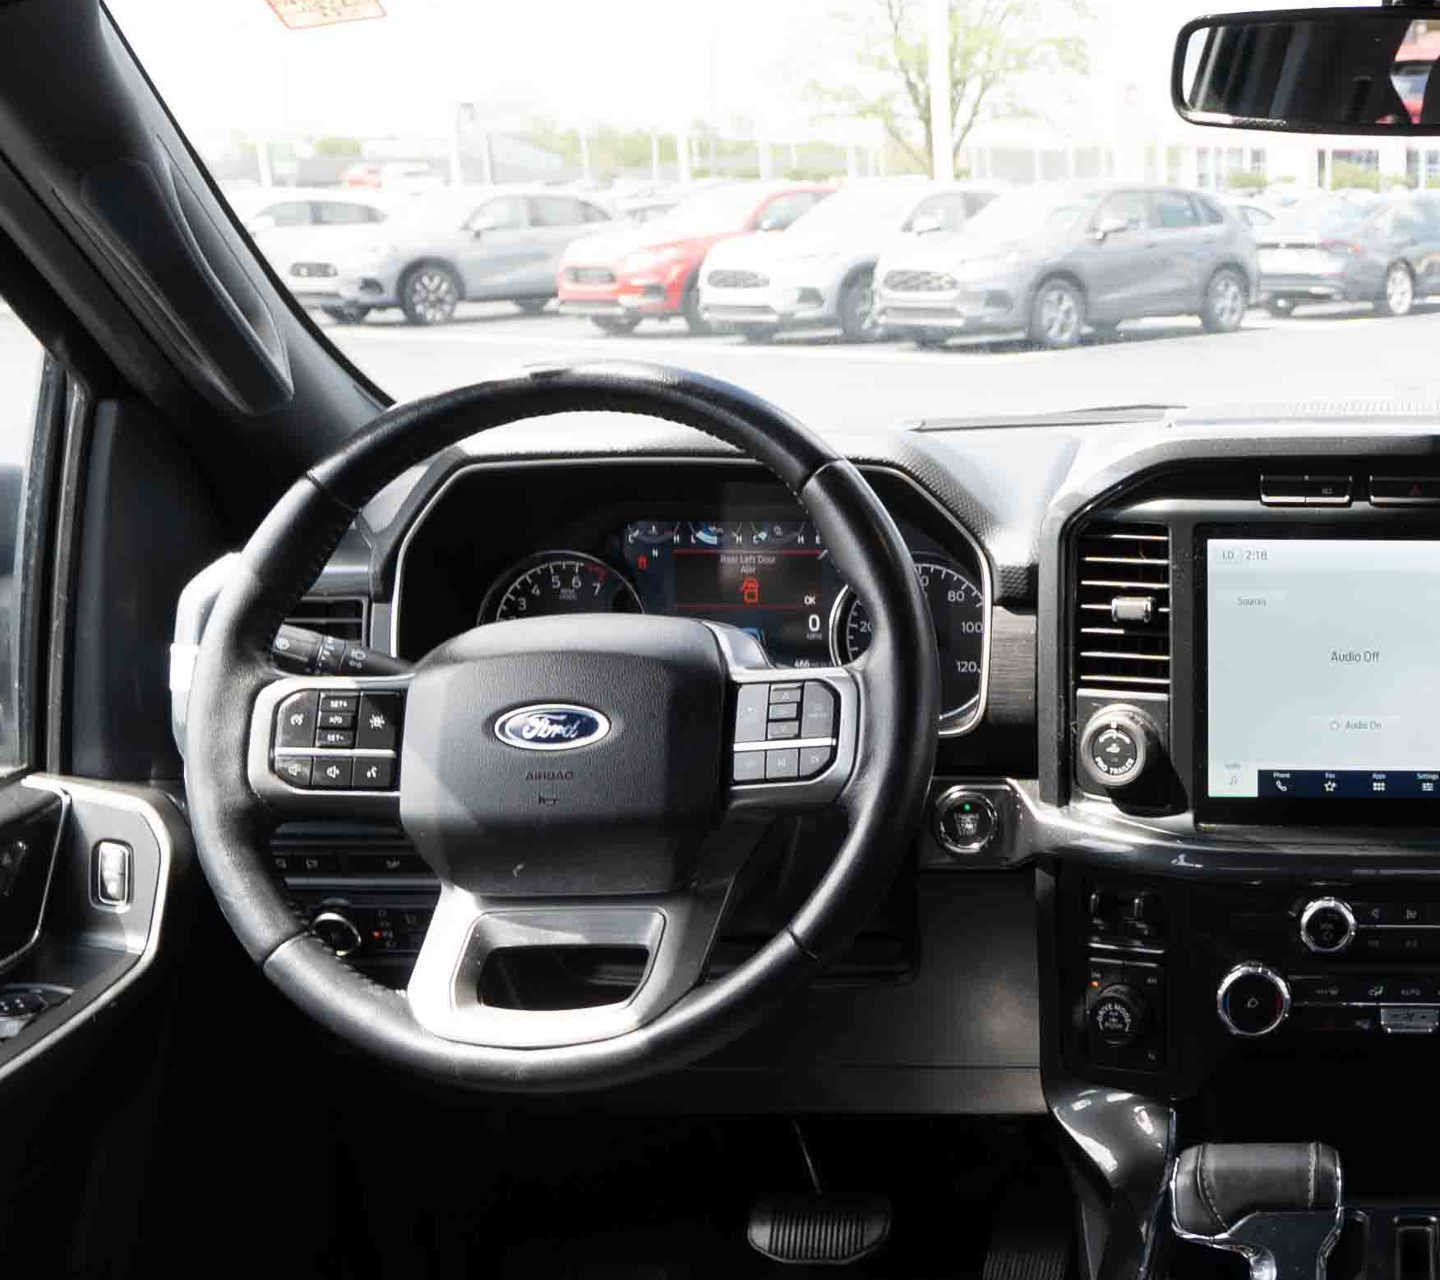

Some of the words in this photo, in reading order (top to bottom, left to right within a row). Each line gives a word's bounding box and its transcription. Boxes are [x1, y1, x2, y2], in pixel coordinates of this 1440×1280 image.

[740, 554, 757, 564] Left
[757, 554, 776, 564] Door
[551, 575, 561, 589] 5
[571, 575, 582, 589] 6
[530, 584, 540, 597] 4
[591, 582, 601, 597] 7
[947, 590, 965, 602] 80
[517, 598, 527, 611] 3
[808, 614, 821, 632] 0
[961, 621, 984, 634] 100
[1330, 650, 1361, 663] Audio
[1363, 650, 1381, 663] Off
[955, 660, 977, 673] 120
[521, 714, 581, 740] Ford
[1344, 719, 1368, 730] Audio
[1369, 719, 1382, 730] On
[1094, 755, 1109, 773] PRO
[1108, 757, 1135, 777] TRAILER
[525, 770, 575, 782] AIRBAG
